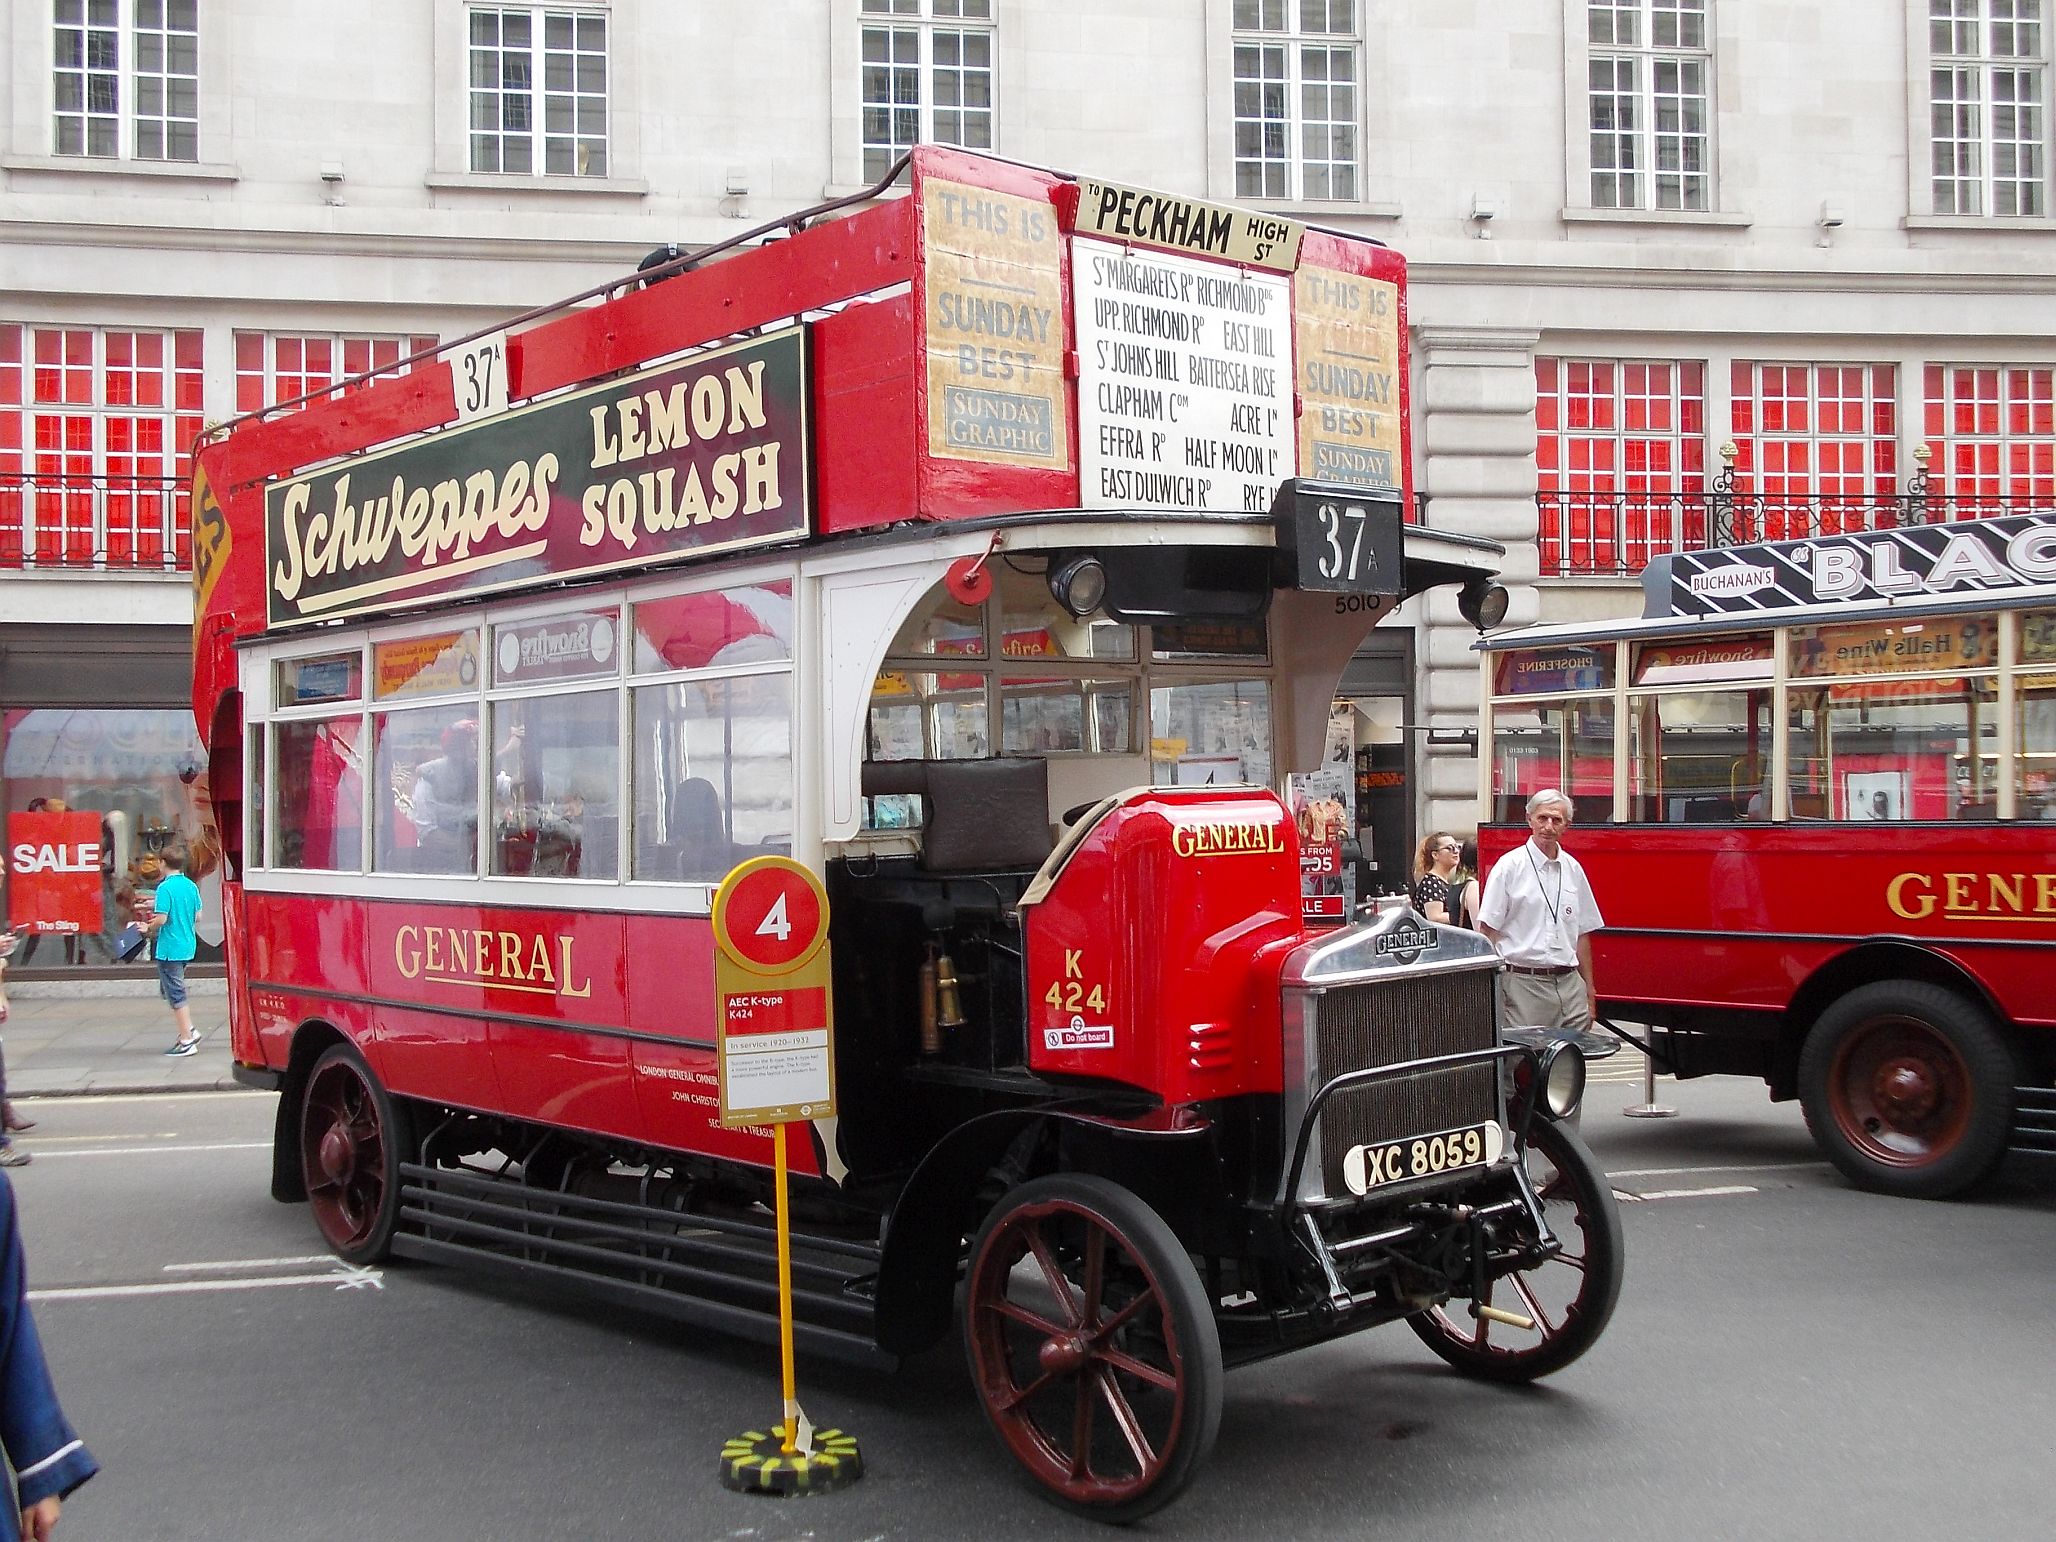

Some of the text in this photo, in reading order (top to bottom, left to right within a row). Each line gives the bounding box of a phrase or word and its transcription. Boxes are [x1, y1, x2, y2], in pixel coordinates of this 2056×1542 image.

[938, 191, 1046, 242] THIS IS
[1089, 184, 1290, 254] TO PECKHAM HIGH
[1254, 243, 1273, 261] ST
[1093, 256, 1105, 286] ST
[1107, 258, 1178, 300] MARGARETS
[1180, 273, 1194, 302] RD
[1197, 277, 1256, 314] RICHMOND
[1306, 276, 1388, 317] THIS IS
[939, 292, 1052, 344] SUNDAY
[1094, 297, 1275, 358] UPP. RICHMOND RD EAST HILL
[958, 343, 1036, 383] BEST
[1097, 340, 1276, 398] ST JOHNS HILL BATTERSEA RISE
[1306, 361, 1391, 405] SUNDAY
[590, 360, 767, 469] LEMON
[953, 391, 1045, 425] SUNDAY
[1098, 382, 1163, 421] CLAPHAM
[1230, 403, 1261, 436] ACRE
[1321, 405, 1380, 438] BEST
[950, 418, 1049, 451] GRAPHIC
[1099, 424, 1144, 460] EFFRA
[1152, 432, 1166, 462] RD
[1185, 437, 1217, 468] HALF
[1222, 442, 1264, 475] MOON
[1318, 446, 1385, 475] SUNDAY
[580, 441, 782, 551] SQUASH
[1101, 467, 1133, 500] EAST
[1135, 472, 1194, 506] DULWICH
[1198, 479, 1212, 508] RD
[1243, 484, 1266, 512] RYE
[274, 453, 559, 601] Schweppes
[1693, 570, 1772, 592] BUCHANAN'S
[1172, 820, 1285, 857] GENERAL
[1308, 847, 1333, 855] FROM
[13, 843, 101, 873] SALE
[1302, 900, 1323, 912] LE
[1886, 872, 2056, 919] GENE
[36, 920, 54, 931] The
[755, 890, 792, 941] 4
[1376, 929, 1437, 954] GENERAL
[395, 925, 591, 998] GENERAL
[1065, 949, 1083, 979] K
[729, 995, 783, 1007] AEC K-type
[729, 1009, 753, 1020] K424
[1045, 981, 1106, 1014] 424
[740, 1041, 768, 1049] service
[1066, 1032, 1106, 1042] Do not board
[640, 1065, 667, 1077] LONDON
[668, 1069, 695, 1083] GENERAL
[672, 1091, 720, 1107] JOHN CHRISTO
[748, 1125, 775, 1139] TREASUR
[1367, 1130, 1481, 1186] XC 8059
